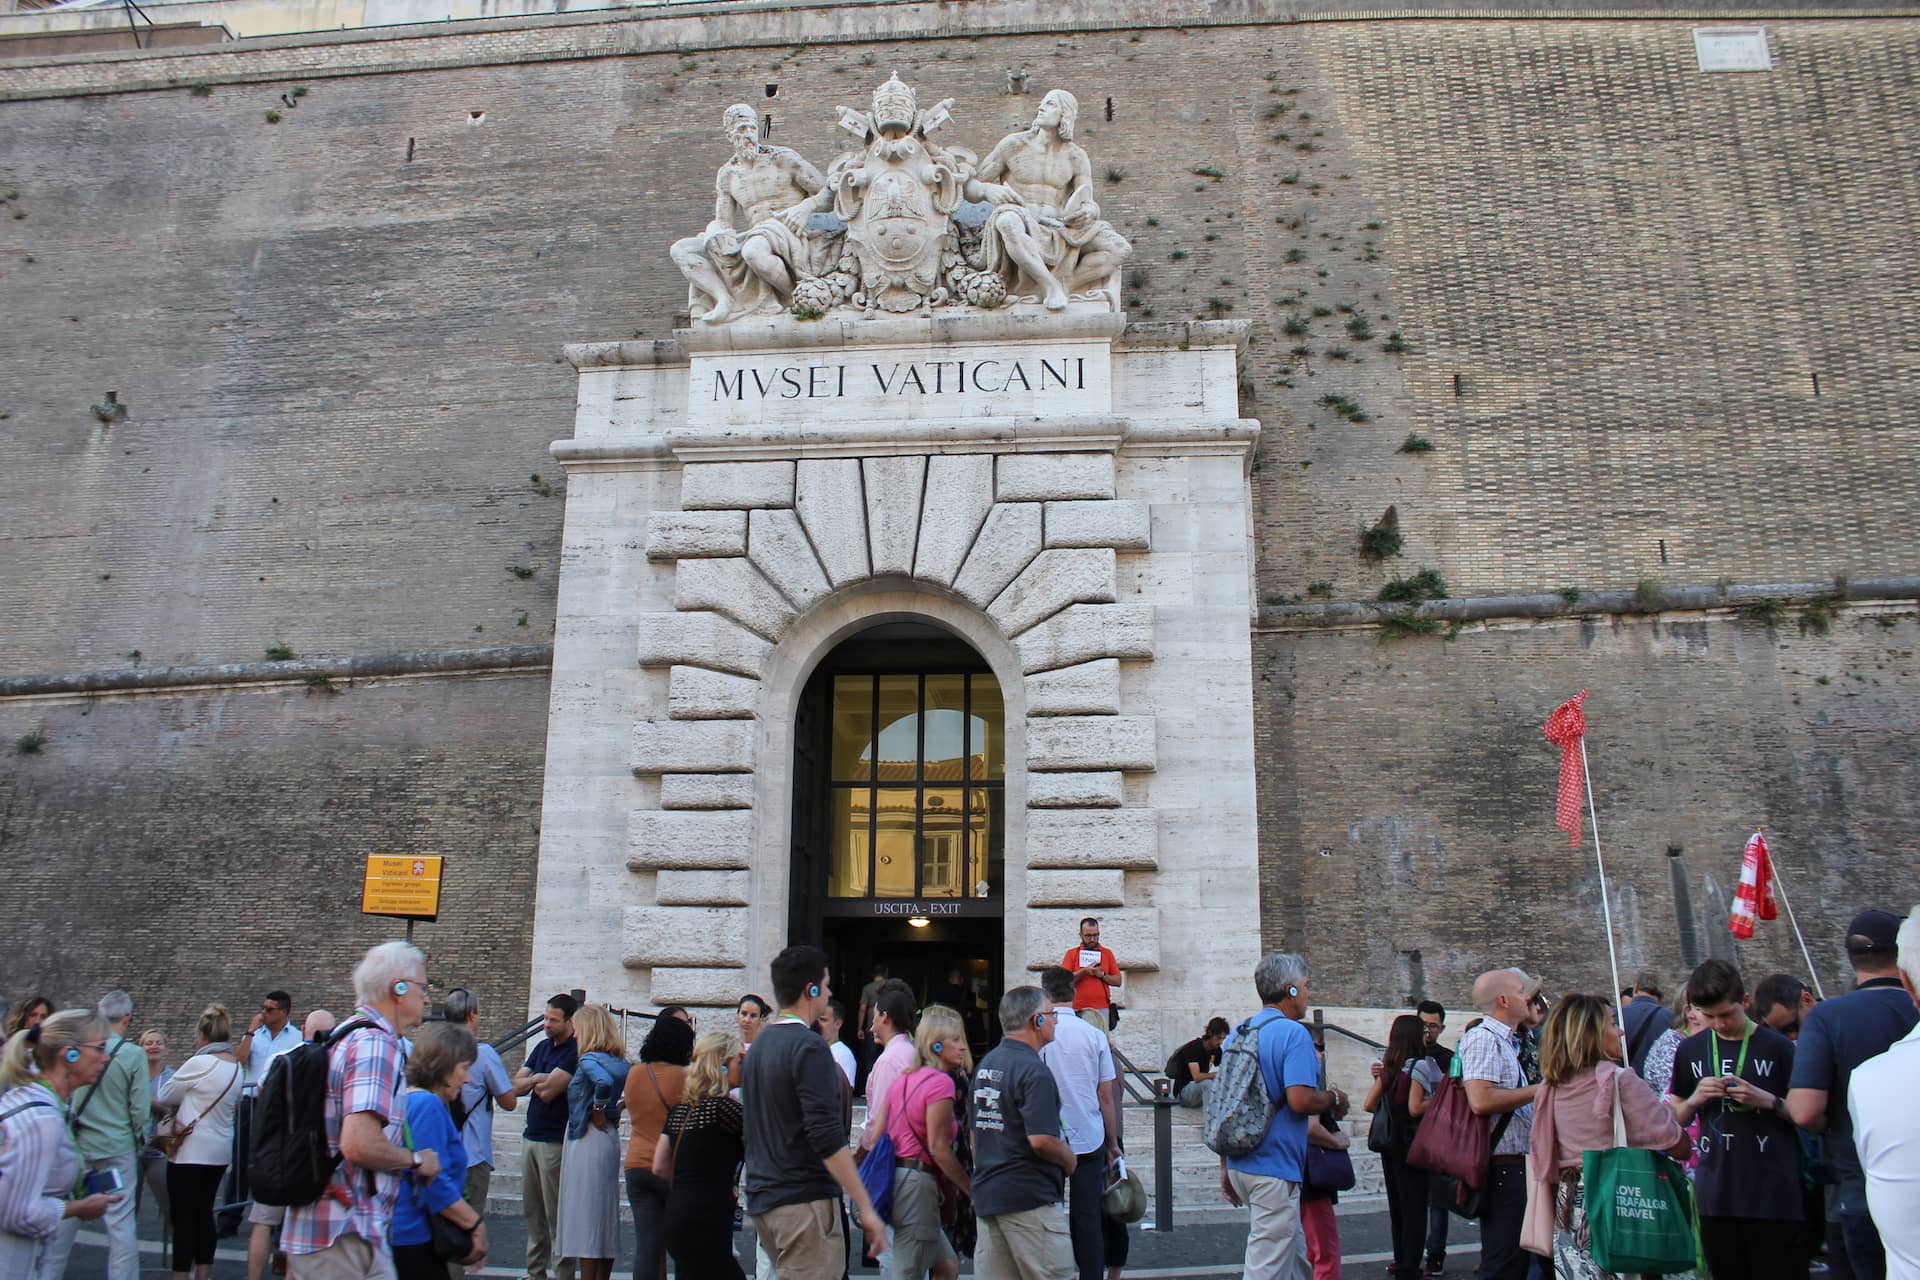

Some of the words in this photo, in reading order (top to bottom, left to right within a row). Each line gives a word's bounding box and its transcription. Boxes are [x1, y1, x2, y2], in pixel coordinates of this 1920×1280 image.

[713, 365, 848, 402] MVSEI
[871, 357, 1087, 396] VATICANI
[874, 903, 919, 914] USCITA
[930, 903, 961, 914] EXIT
[1616, 1206, 1656, 1220] TRAVEL
